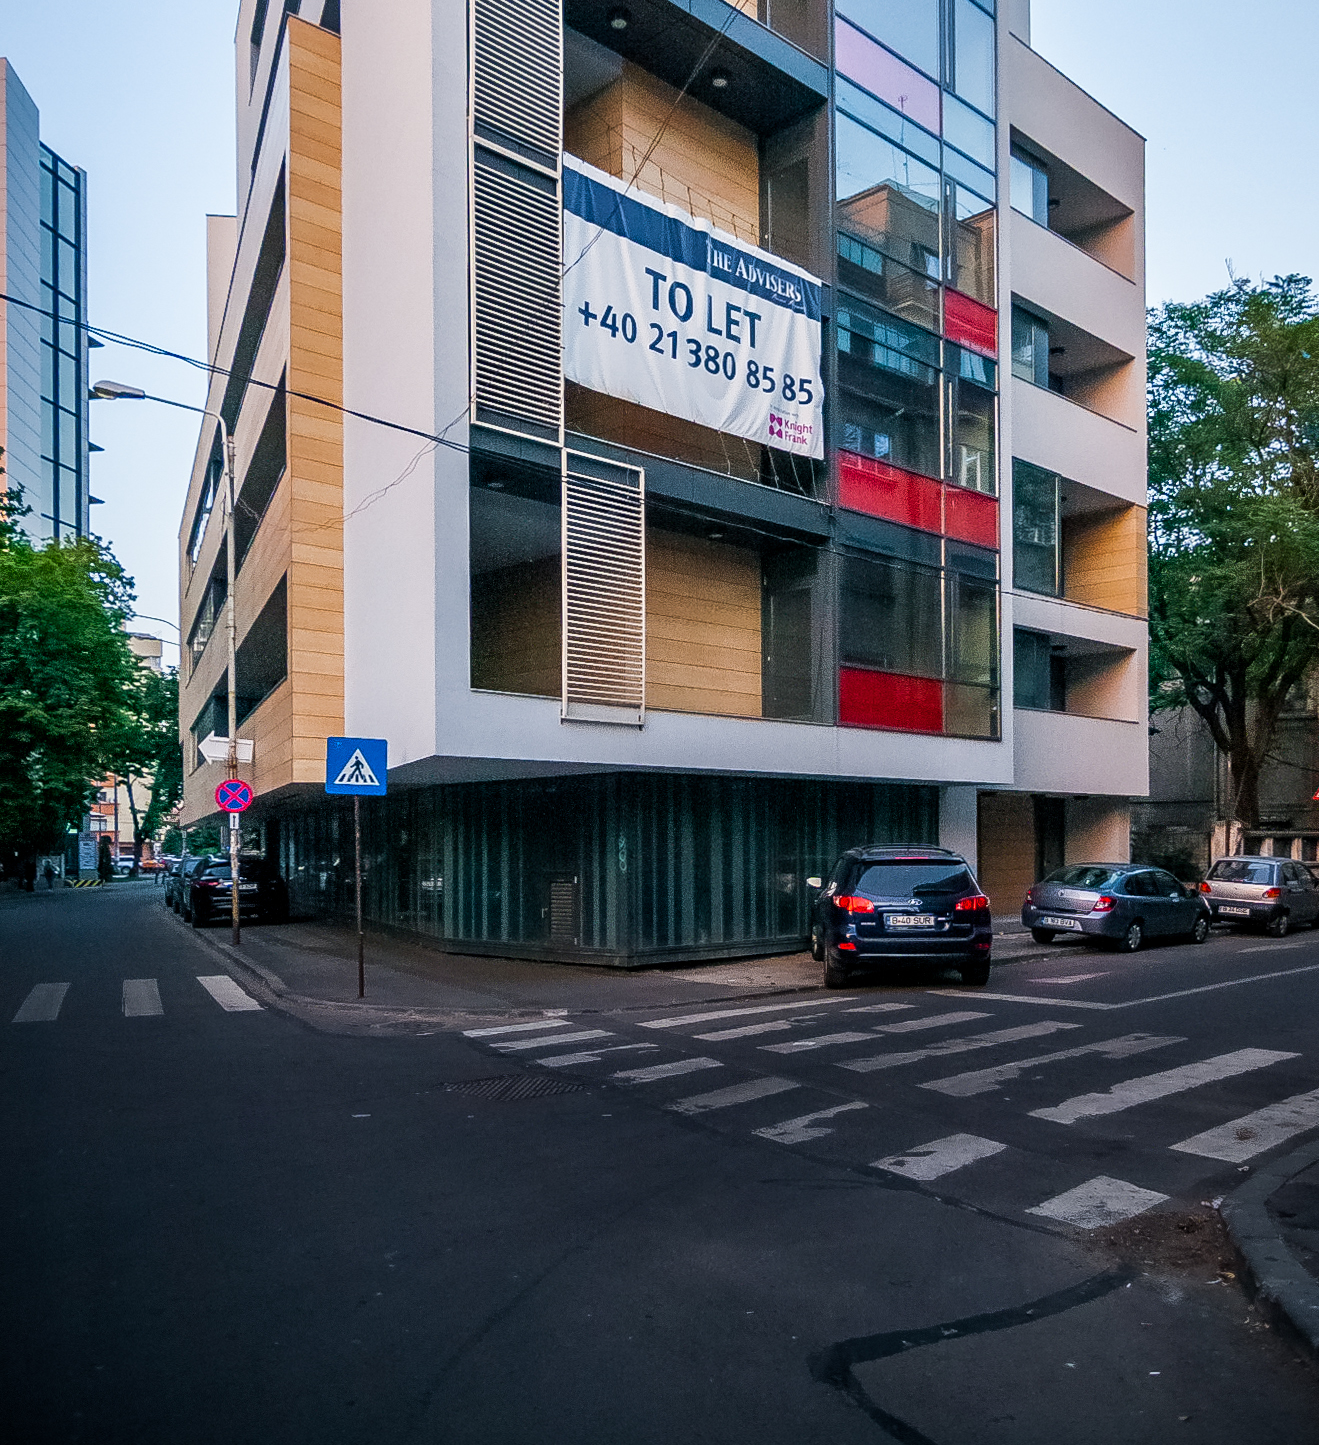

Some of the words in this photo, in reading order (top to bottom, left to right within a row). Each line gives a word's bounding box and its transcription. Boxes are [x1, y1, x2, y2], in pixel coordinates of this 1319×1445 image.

[706, 235, 732, 273] THE
[735, 257, 802, 302] ADVISERS
[645, 267, 694, 323] TO
[707, 294, 762, 349] LET
[578, 301, 638, 344] +40
[649, 323, 678, 360] 21
[686, 338, 736, 381] 380
[746, 359, 776, 394] 85
[782, 373, 814, 405] 85
[784, 419, 813, 435] Knight
[784, 431, 808, 445] Frank
